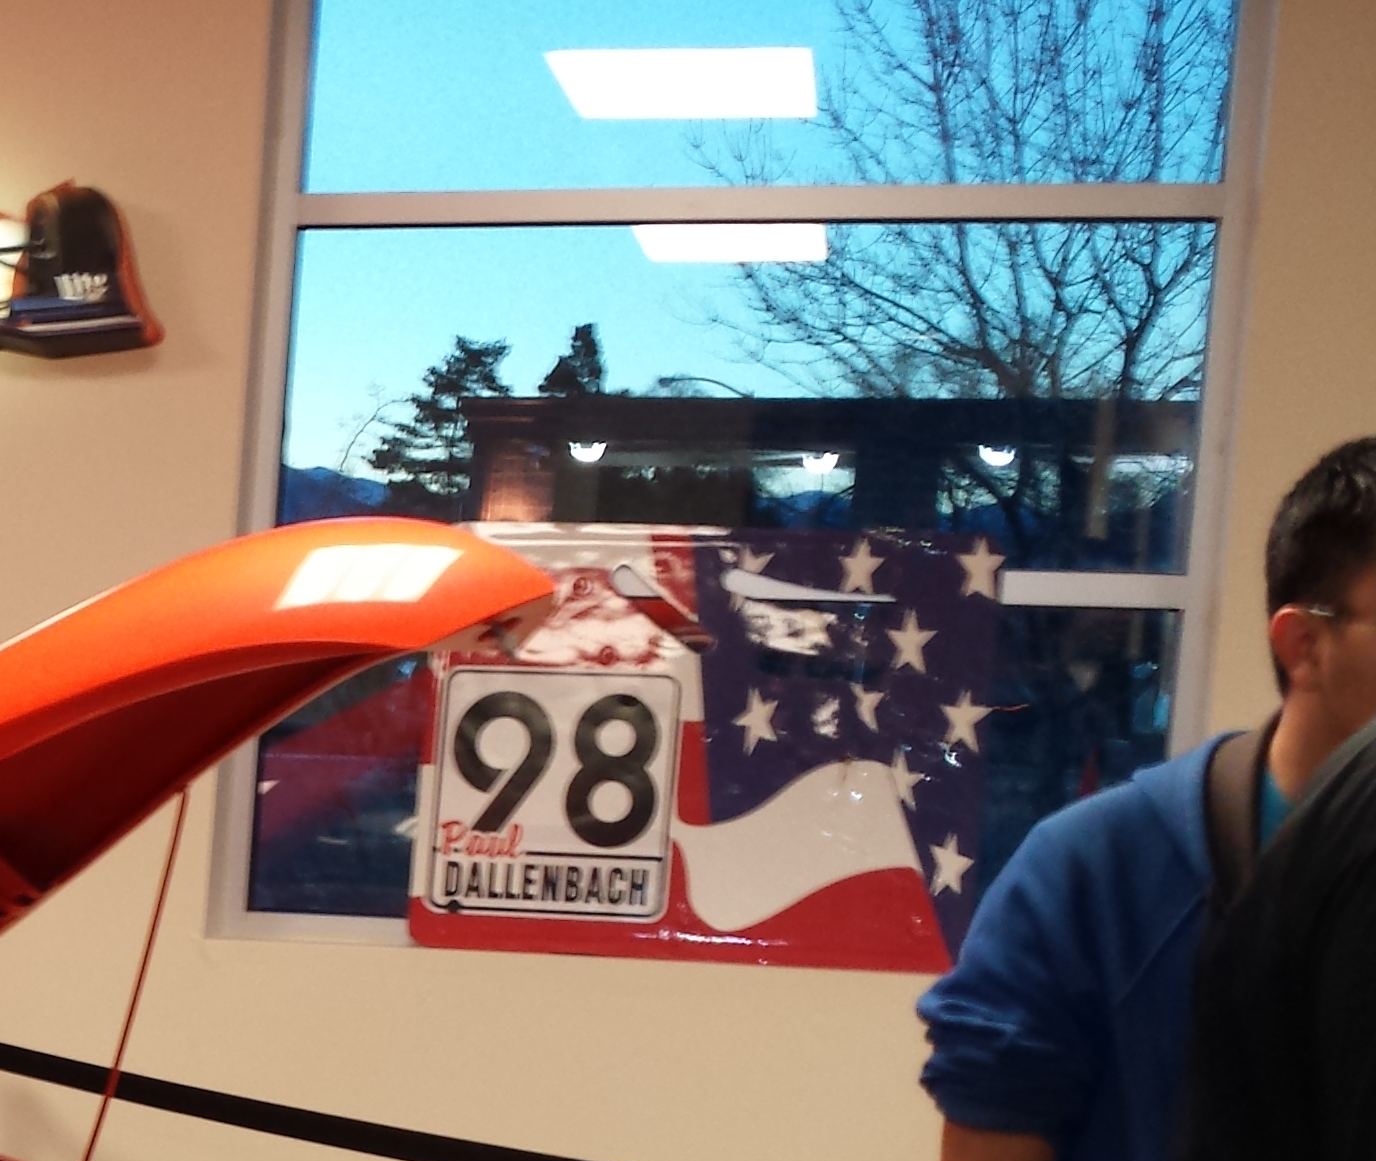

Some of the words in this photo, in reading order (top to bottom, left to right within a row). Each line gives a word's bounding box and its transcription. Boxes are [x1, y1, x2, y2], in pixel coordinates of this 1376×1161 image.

[453, 690, 659, 848] 98
[439, 820, 524, 858] Paul
[444, 860, 649, 906] DALLENBACH
